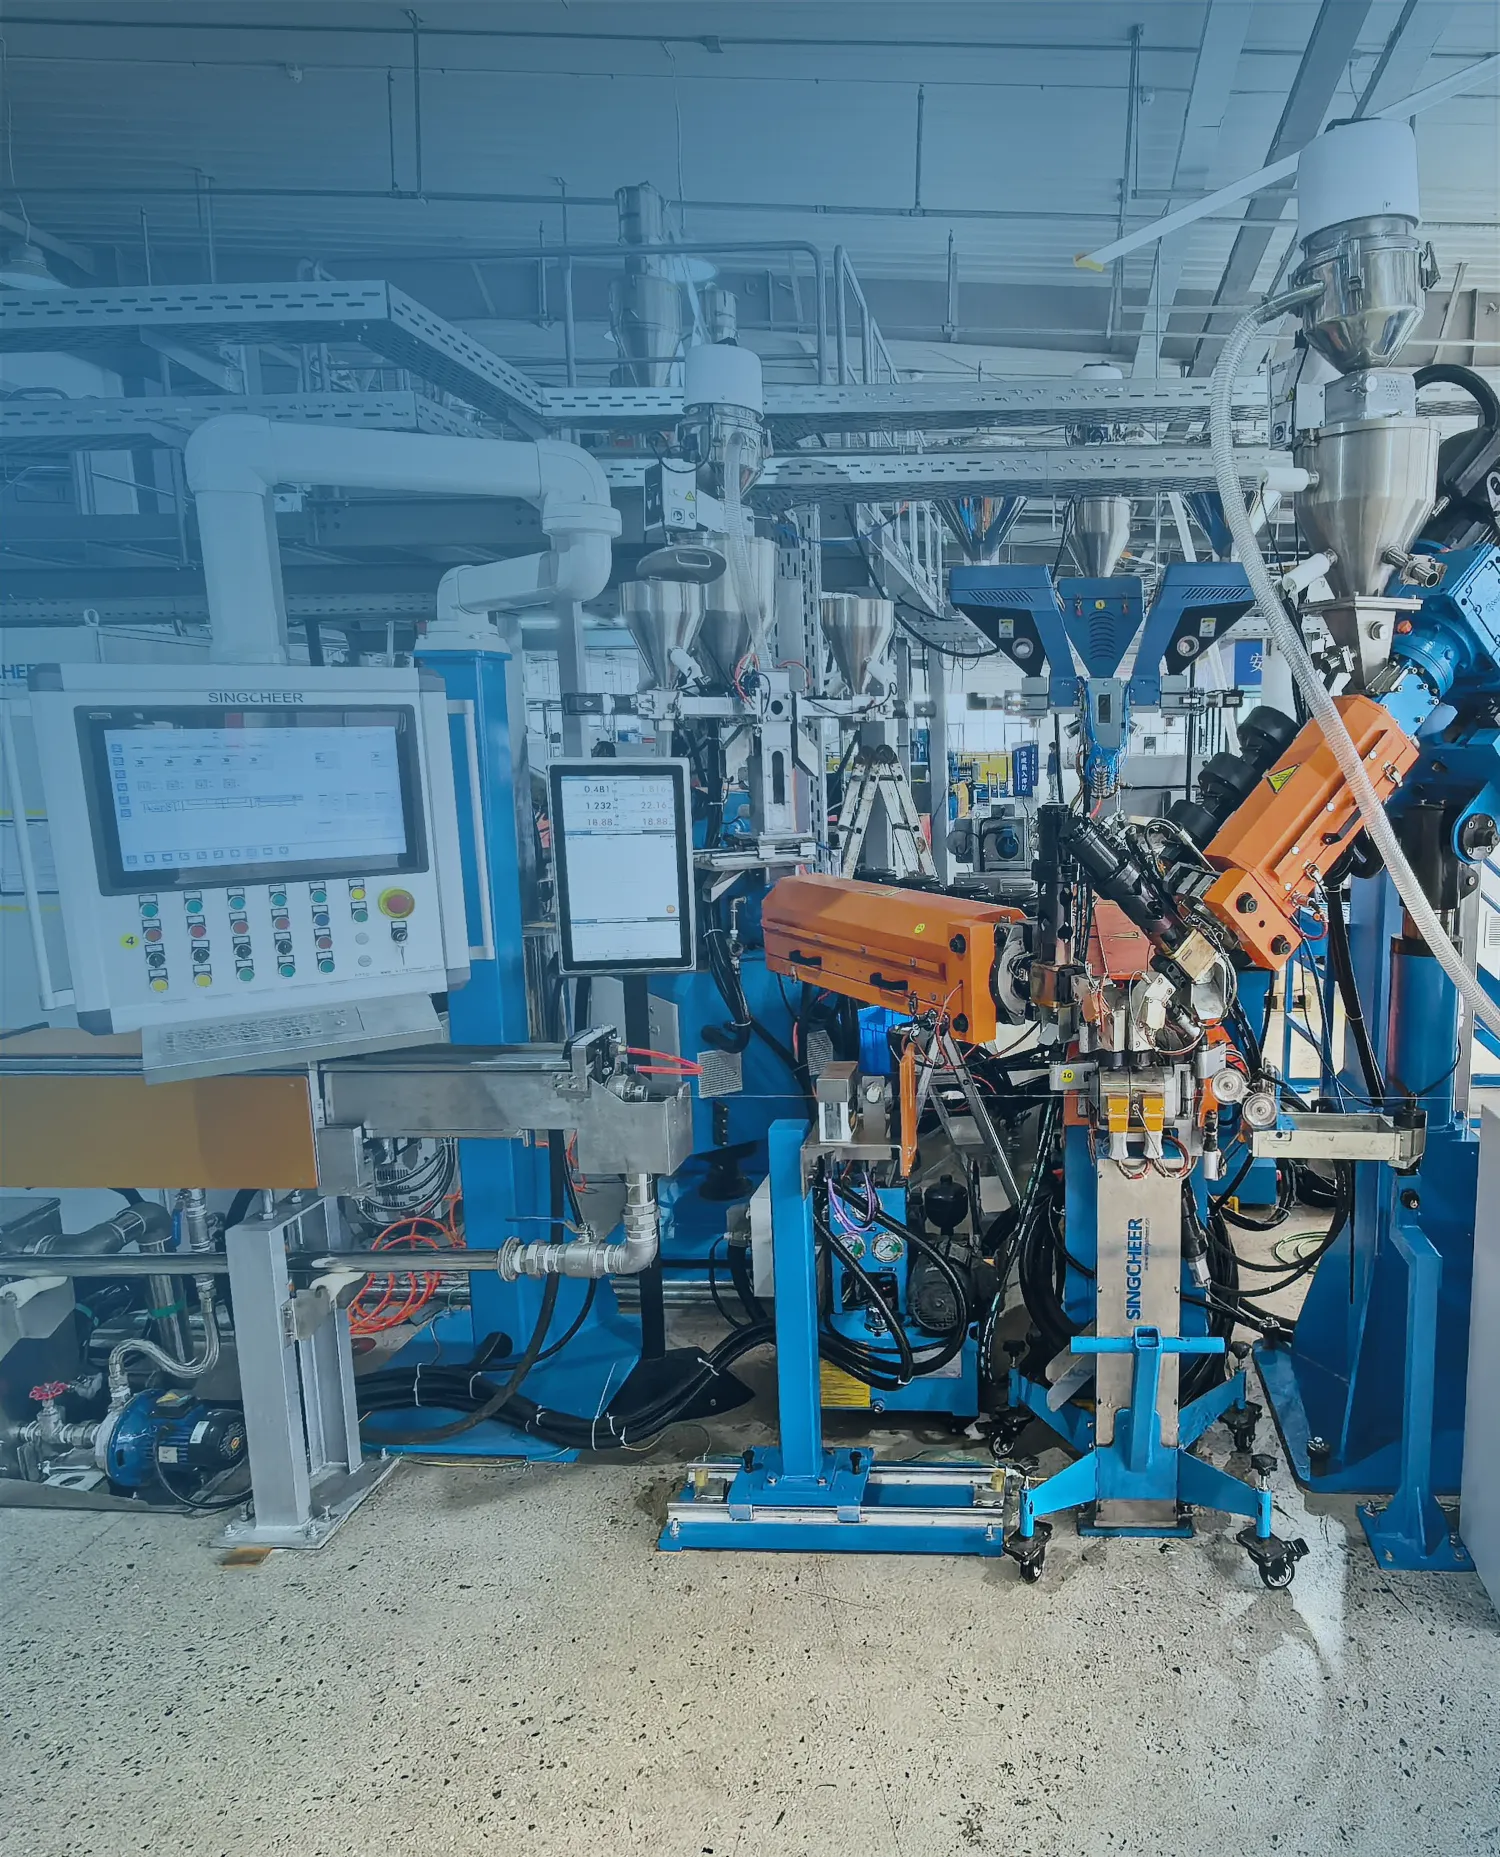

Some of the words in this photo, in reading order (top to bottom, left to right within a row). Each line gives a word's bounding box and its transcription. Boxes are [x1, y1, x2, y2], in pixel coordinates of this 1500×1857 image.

[208, 692, 304, 703] SINGCHEER
[125, 936, 134, 945] 4
[1126, 1218, 1143, 1320] SINGCHEER
